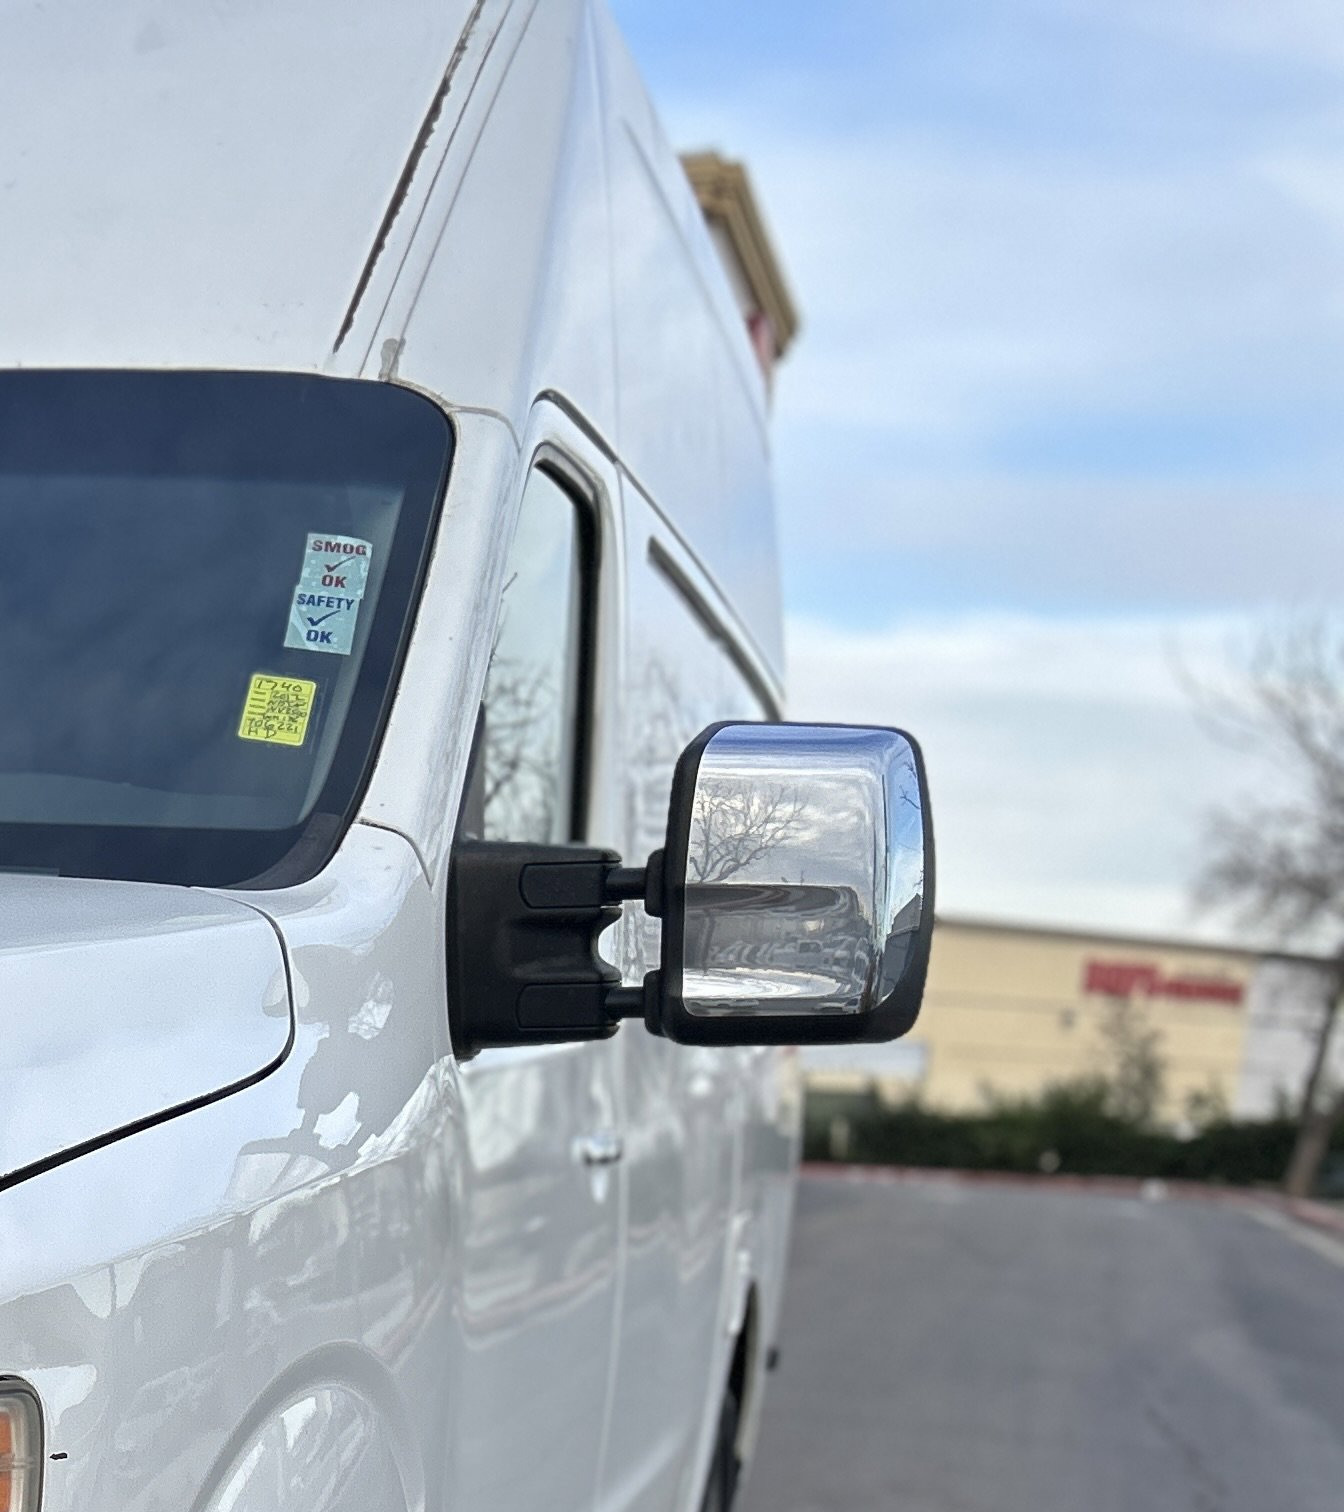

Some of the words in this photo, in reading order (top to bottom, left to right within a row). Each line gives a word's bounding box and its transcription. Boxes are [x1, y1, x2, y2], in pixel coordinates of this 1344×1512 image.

[312, 540, 367, 556] SMOG
[321, 574, 348, 589] OK
[296, 593, 355, 611] SAFETY
[305, 629, 334, 644] OK
